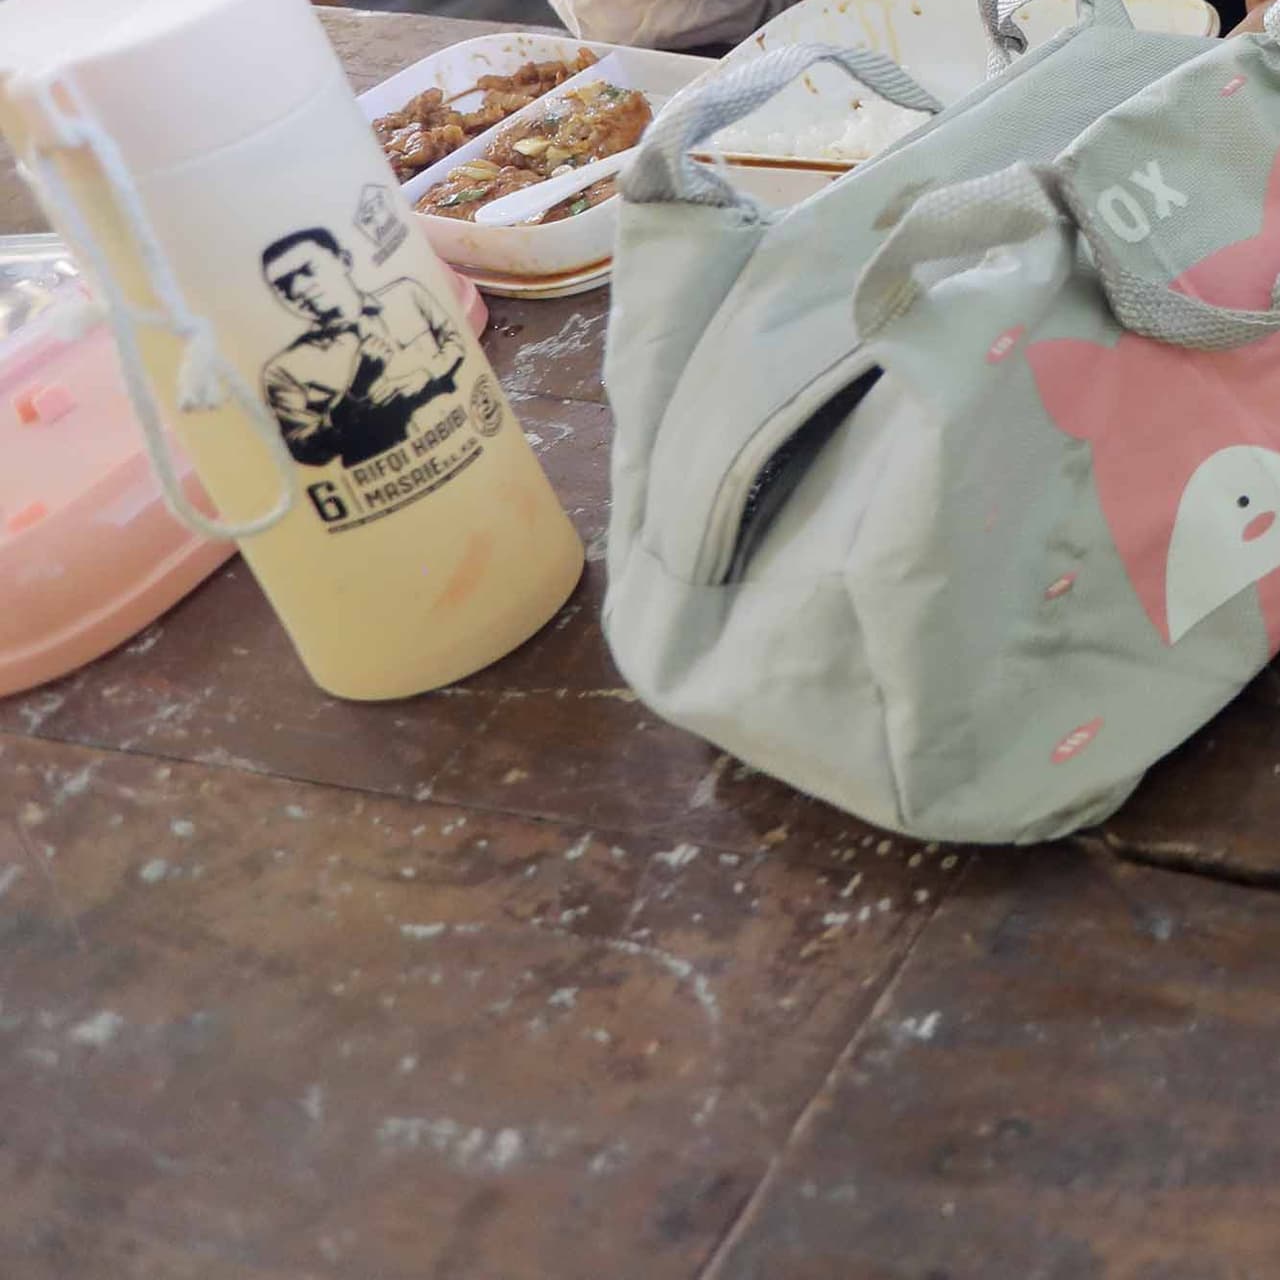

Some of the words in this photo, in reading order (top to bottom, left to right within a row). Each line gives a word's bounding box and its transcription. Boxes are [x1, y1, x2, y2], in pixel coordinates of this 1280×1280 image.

[411, 404, 468, 458] HABIBI
[306, 480, 348, 523] 6
[364, 457, 442, 508] MASRIE
